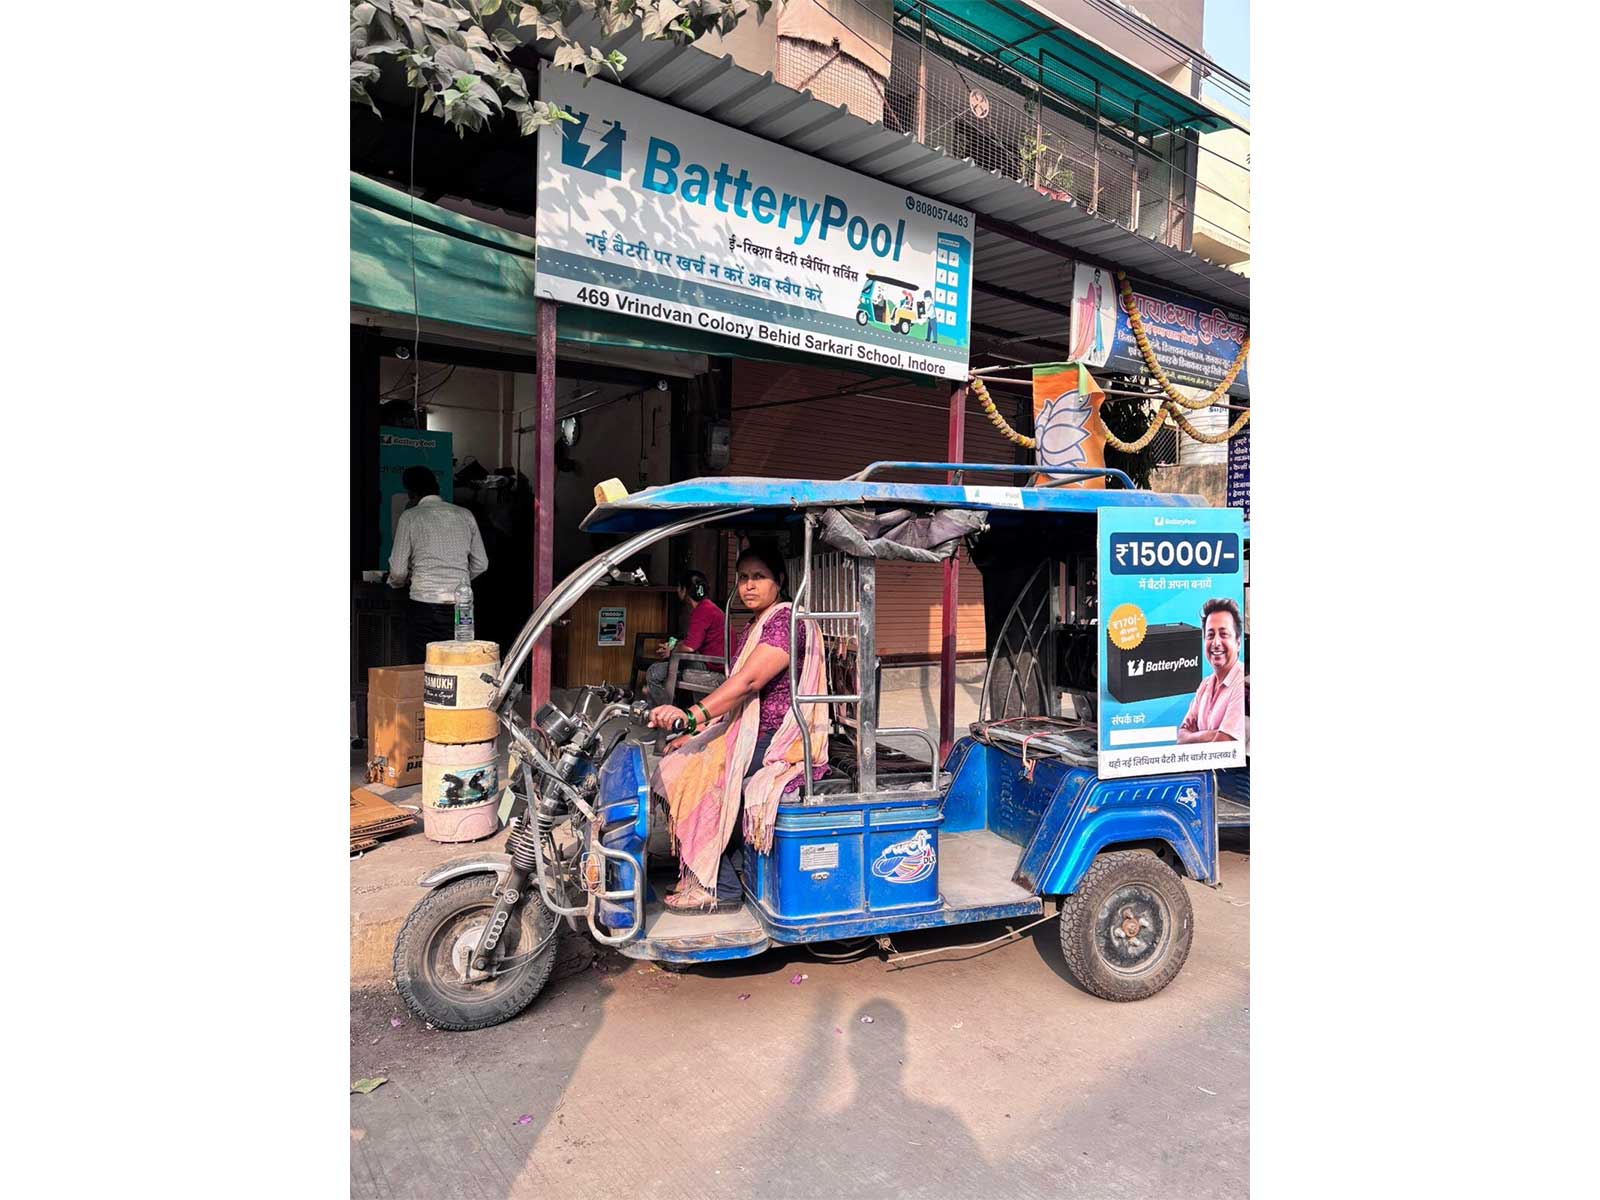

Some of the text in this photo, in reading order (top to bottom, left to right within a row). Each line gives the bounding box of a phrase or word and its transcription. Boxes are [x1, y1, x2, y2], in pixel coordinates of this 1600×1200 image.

[642, 136, 905, 262] BatteryPool
[915, 200, 969, 228] 8080574483
[585, 230, 823, 303] नई बैटरी पर खर्च न करें अब स्वैप करे
[729, 234, 859, 282] ई-रिक्शा बैटरी स्वैपिंग सर्विस
[577, 286, 946, 375] 469 Vrindvan Colony Behid Sarkari School, Indore
[1115, 540, 1235, 567] ₹15000/-
[1138, 578, 1146, 590] में
[1147, 578, 1166, 590] बैटरी
[1145, 656, 1198, 672] BatteryPool
[1178, 753, 1190, 763] और
